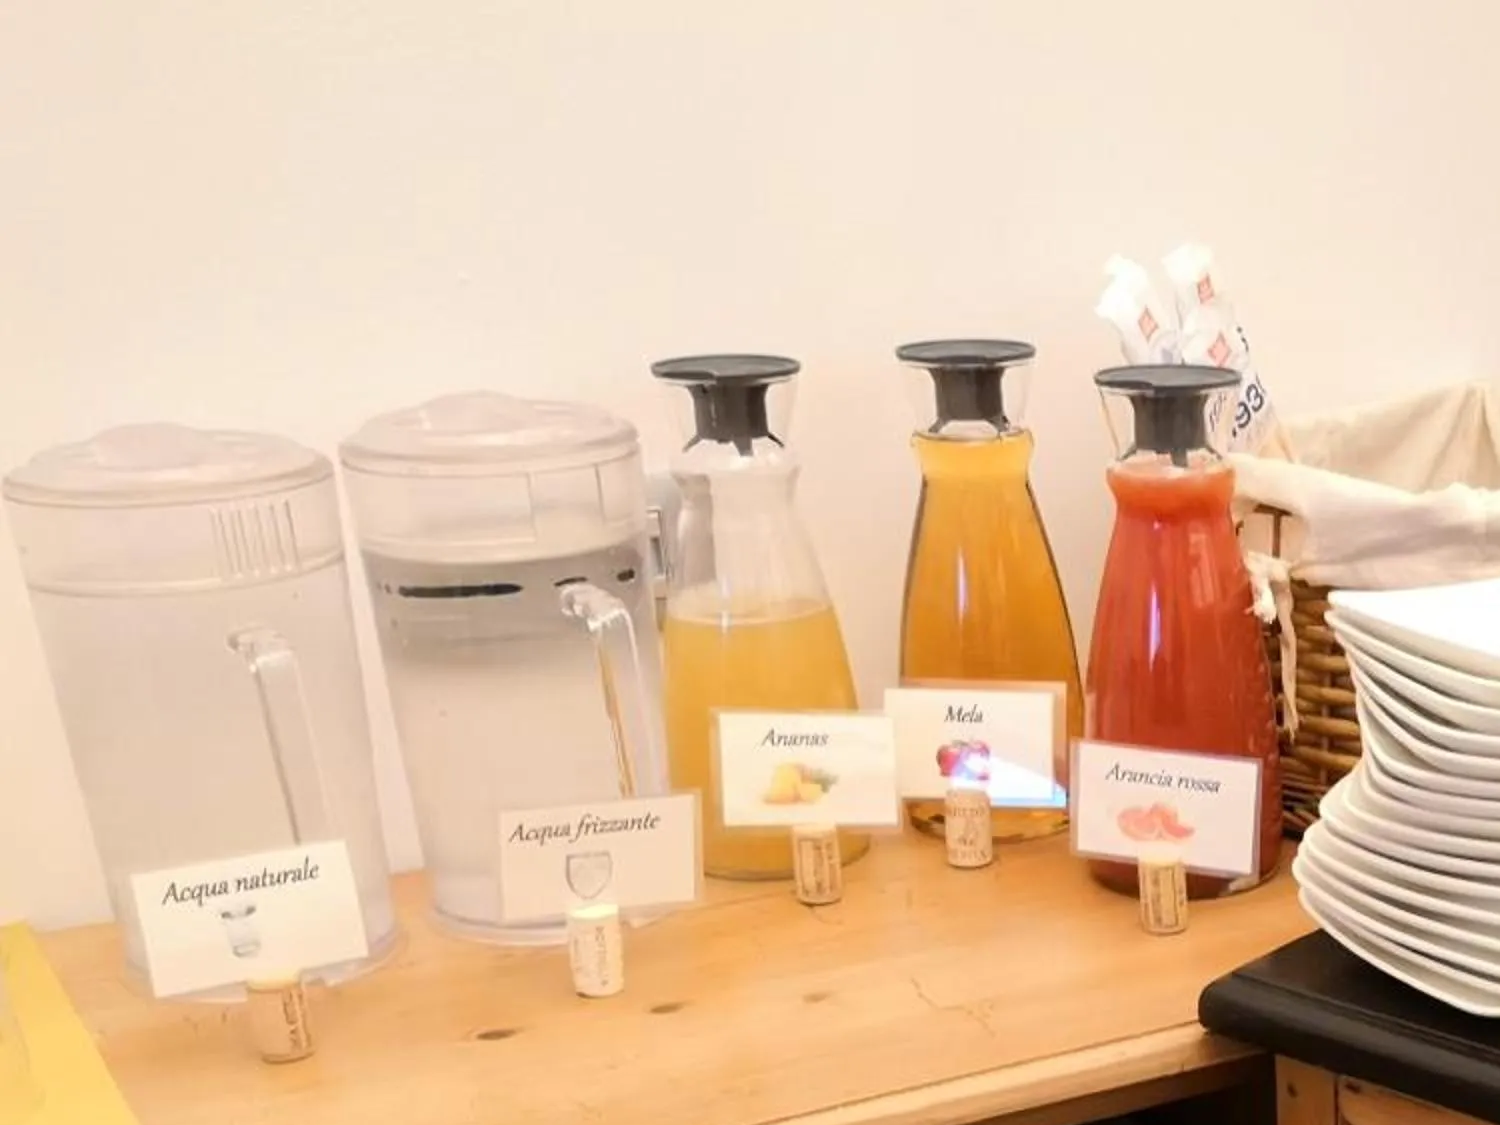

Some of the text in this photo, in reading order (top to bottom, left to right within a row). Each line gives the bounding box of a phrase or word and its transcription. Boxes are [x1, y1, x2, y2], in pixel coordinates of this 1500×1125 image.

[943, 704, 985, 725] Mela
[760, 728, 830, 748] Ananas
[1105, 761, 1223, 795] Arancia rossa
[508, 812, 661, 846] Acqua frizzante
[161, 856, 320, 906] Acqua naturale
